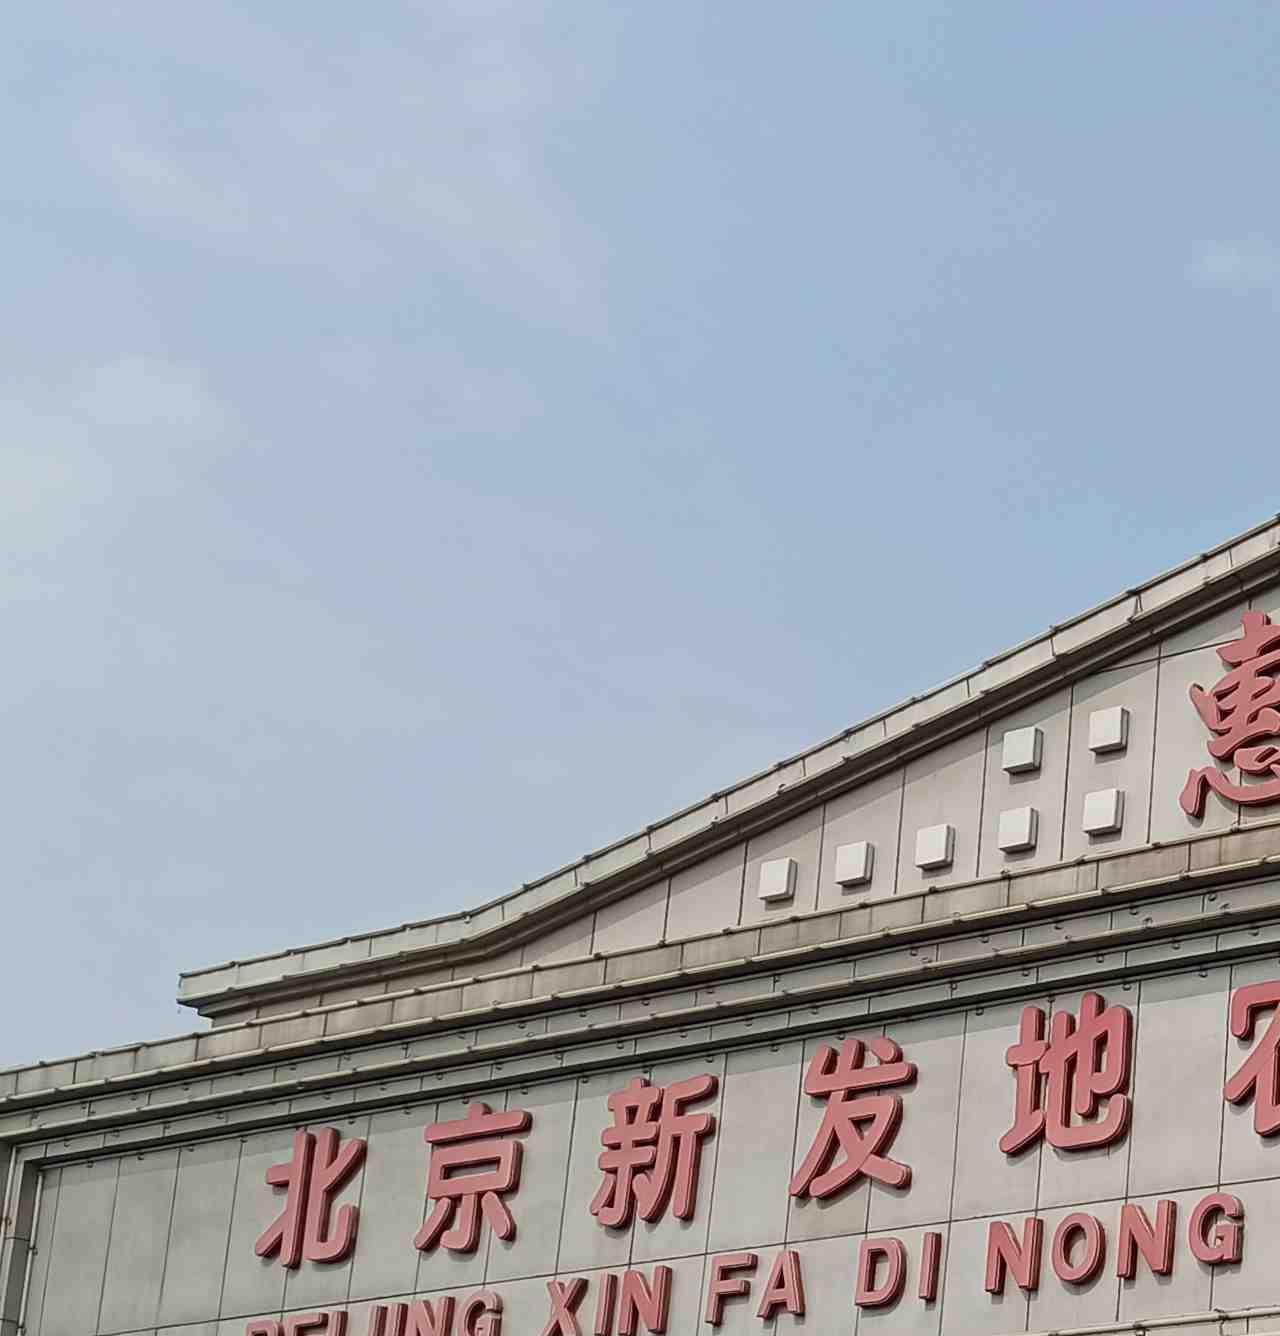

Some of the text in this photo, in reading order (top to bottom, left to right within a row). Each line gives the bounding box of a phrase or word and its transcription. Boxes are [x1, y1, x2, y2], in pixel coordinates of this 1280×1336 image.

[704, 1250, 806, 1328] FA
[854, 1231, 942, 1309] DI
[984, 1192, 1245, 1295] NONG
